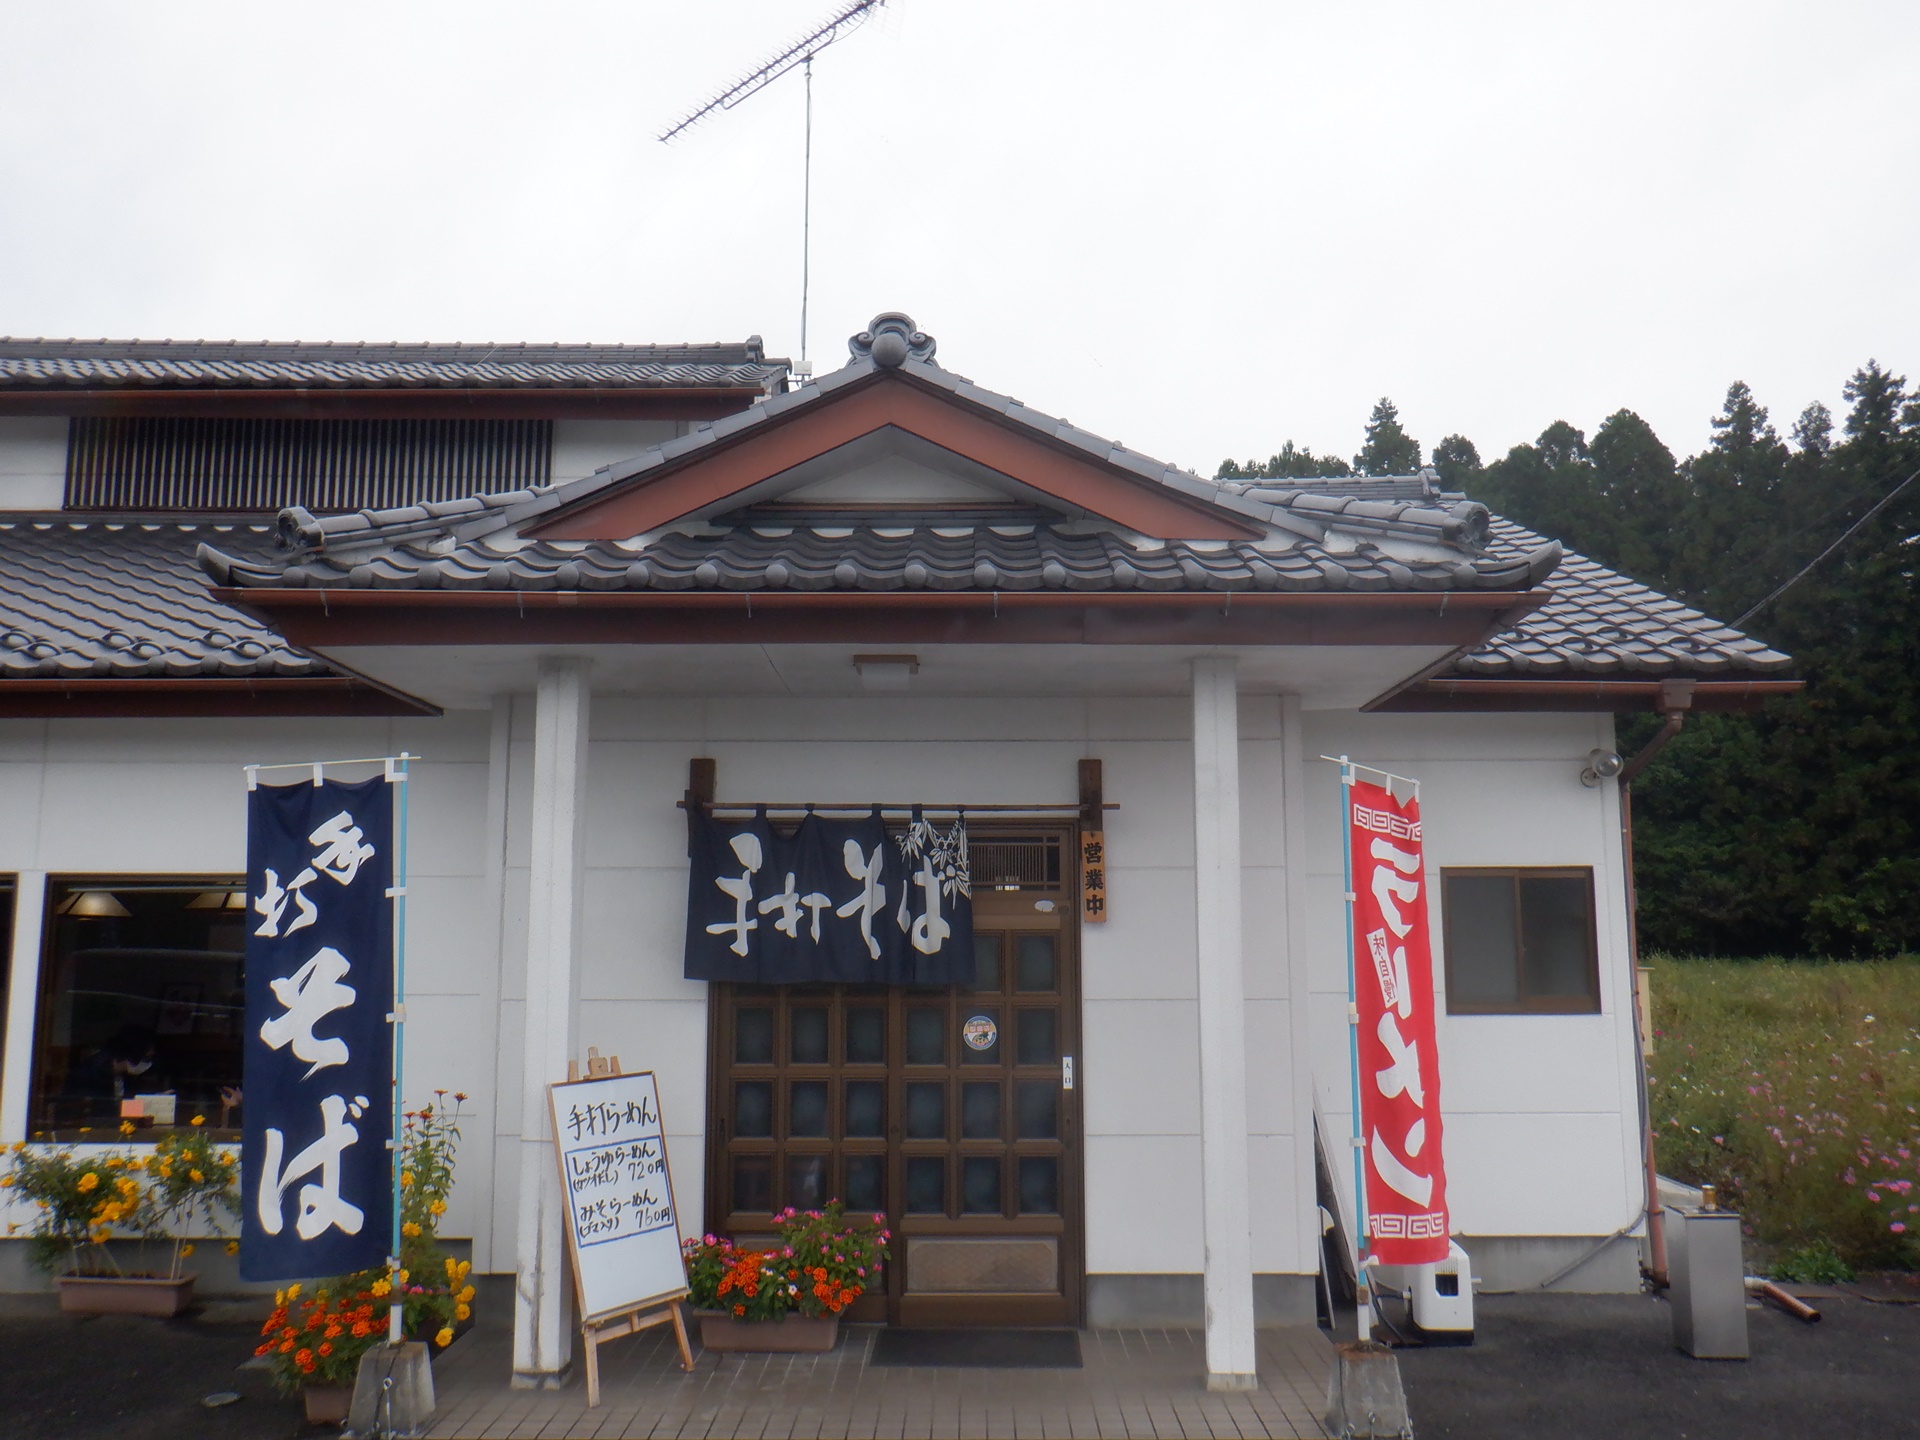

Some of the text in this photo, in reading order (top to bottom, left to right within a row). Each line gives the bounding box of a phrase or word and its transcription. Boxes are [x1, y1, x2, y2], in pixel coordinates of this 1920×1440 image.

[705, 832, 957, 961] 手打そば
[1083, 842, 1104, 916] 営業中
[254, 810, 375, 1241] 手打そば
[567, 1096, 657, 1141] 手打らーめん
[573, 1142, 656, 1176] しょうゆらーめん
[628, 1158, 665, 1181] 720円
[580, 1188, 658, 1222] みそらーめん
[580, 1206, 671, 1239] (ゴマ入り) 760円
